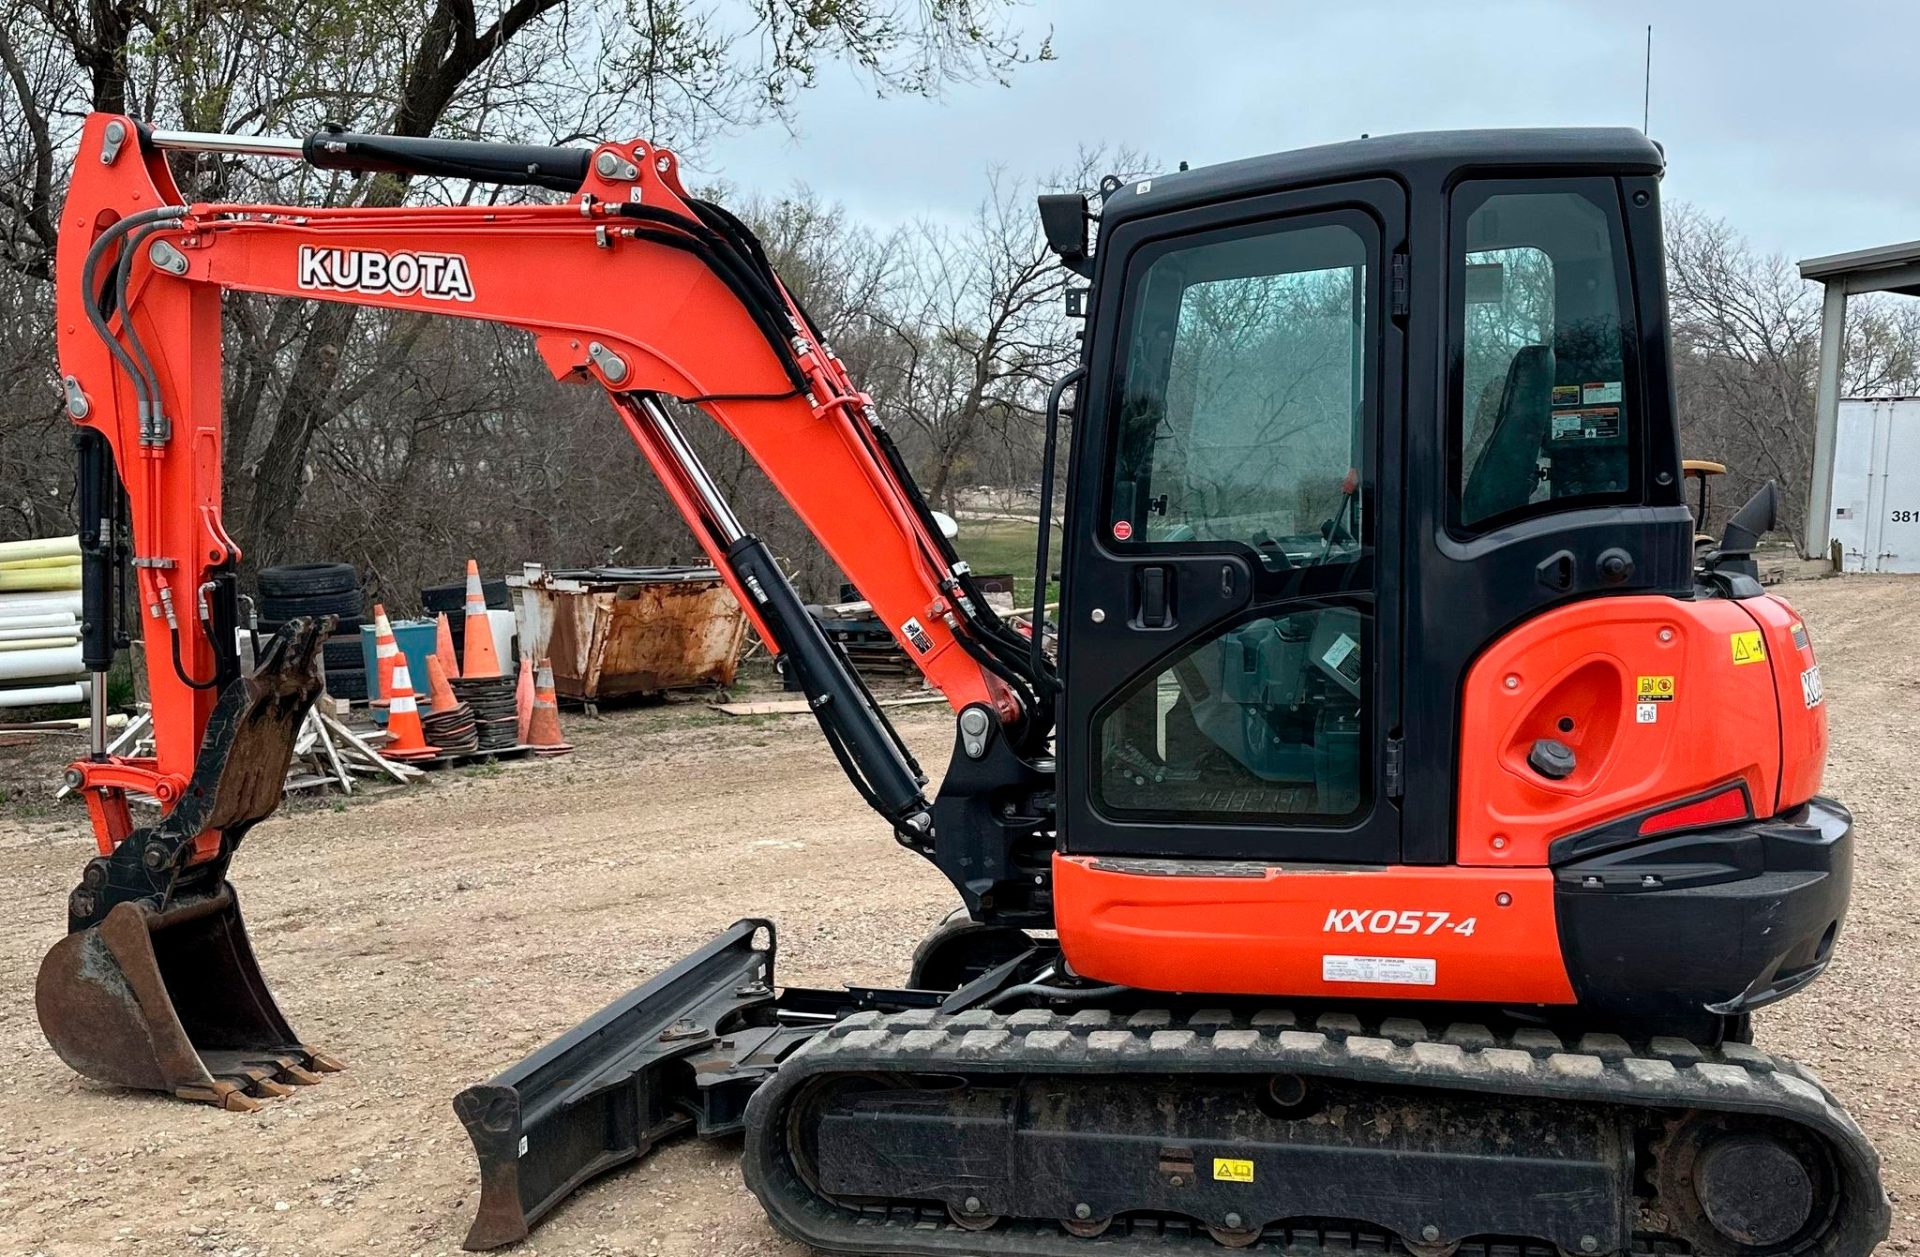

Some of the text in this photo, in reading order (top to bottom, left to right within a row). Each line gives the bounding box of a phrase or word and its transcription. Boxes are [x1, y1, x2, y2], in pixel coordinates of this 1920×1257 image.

[300, 246, 472, 298] KUBOTA
[1891, 510, 1919, 523] 381
[1322, 909, 1477, 937] KX057-4
